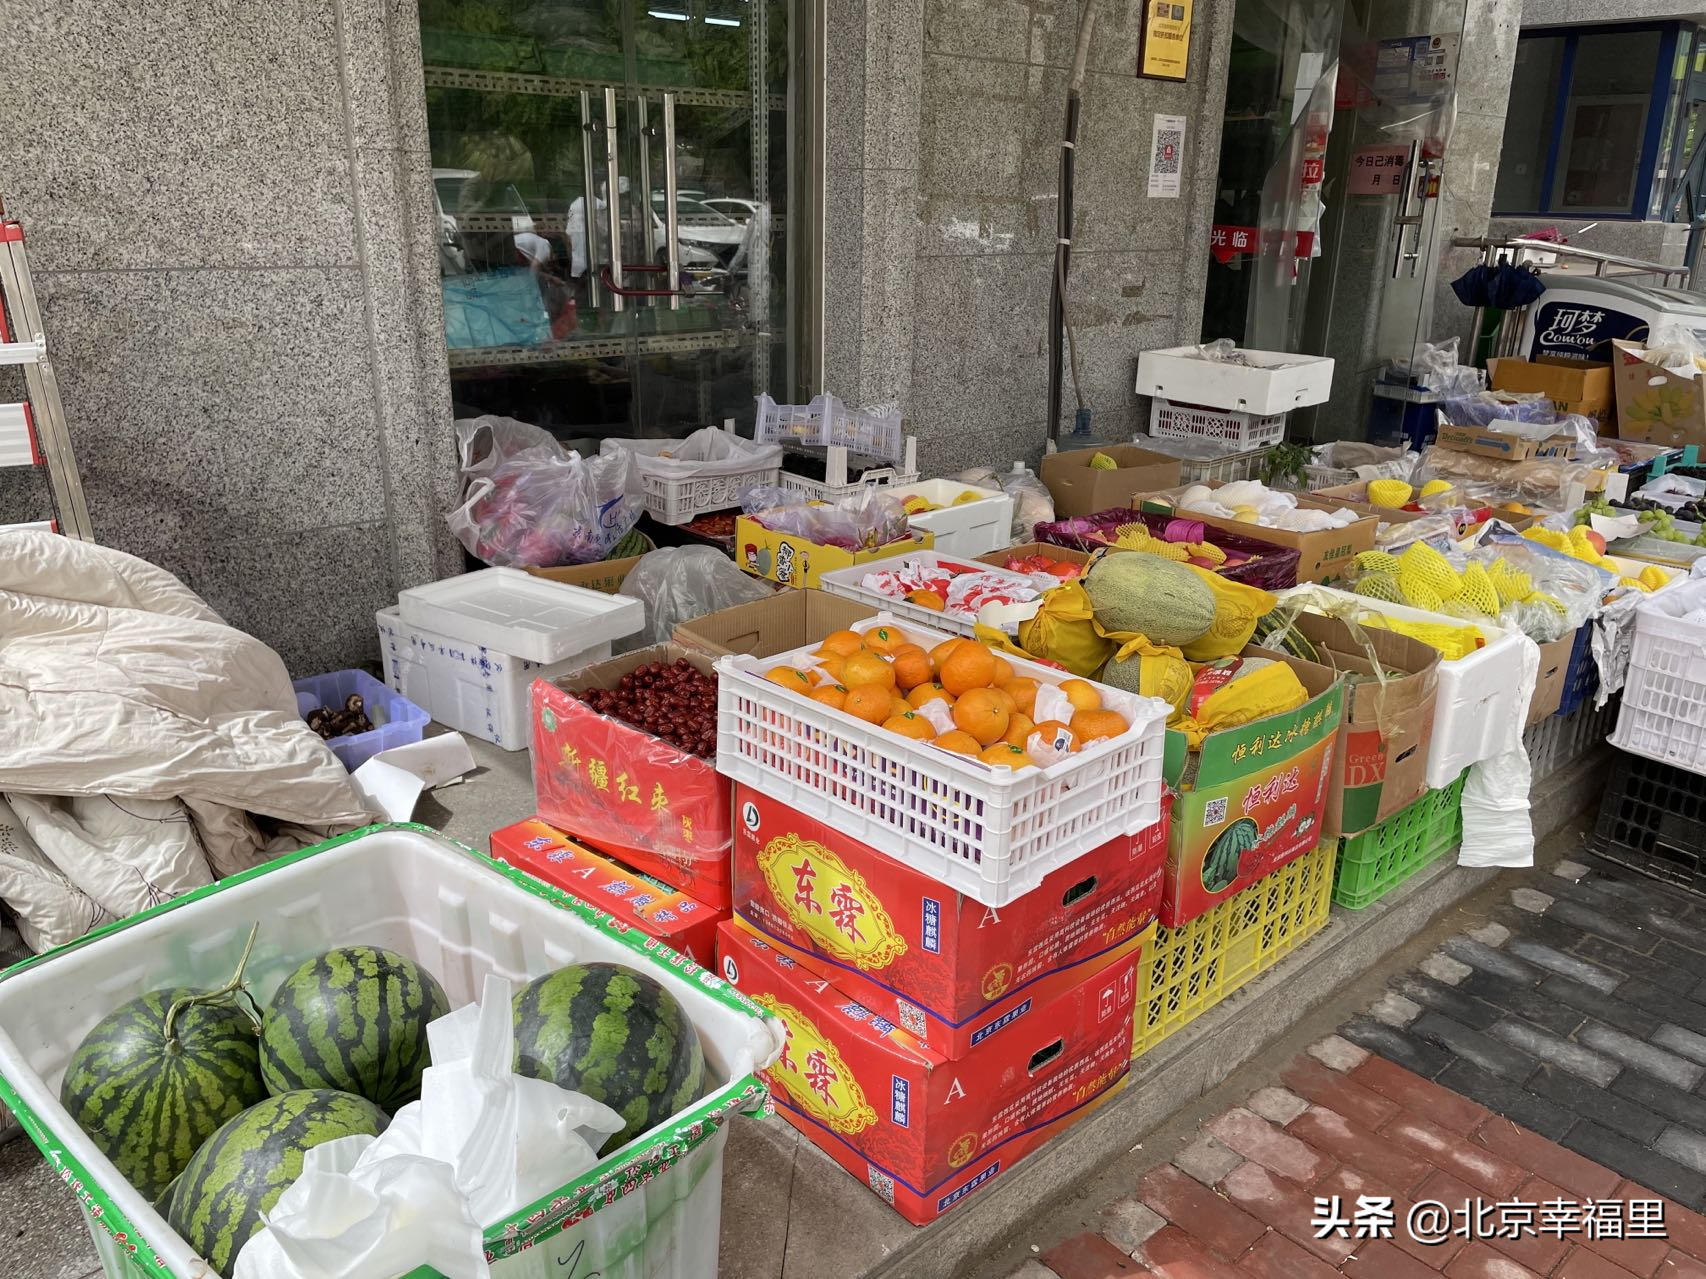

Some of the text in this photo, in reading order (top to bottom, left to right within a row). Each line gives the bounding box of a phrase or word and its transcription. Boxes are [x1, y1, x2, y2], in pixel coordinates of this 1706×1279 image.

[1211, 229, 1249, 248] 光临
[1548, 308, 1606, 334] 珂梦
[1349, 753, 1384, 765] Green
[943, 1076, 967, 1106] A
